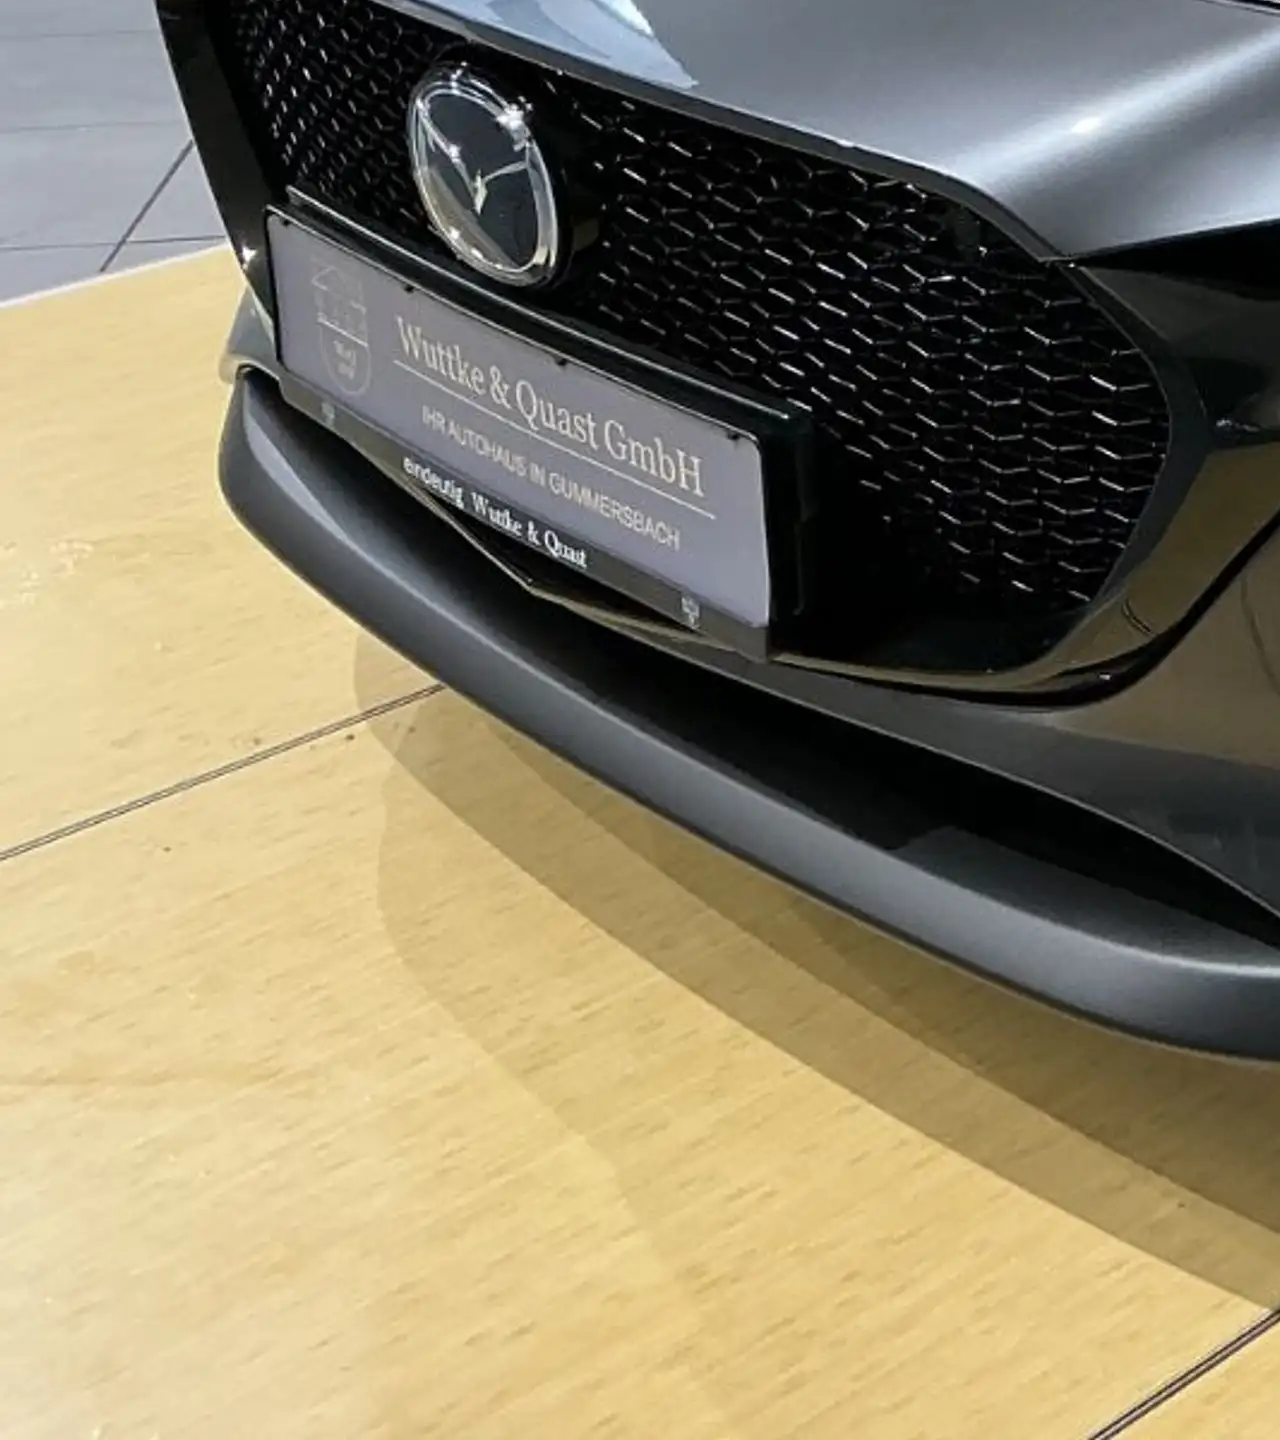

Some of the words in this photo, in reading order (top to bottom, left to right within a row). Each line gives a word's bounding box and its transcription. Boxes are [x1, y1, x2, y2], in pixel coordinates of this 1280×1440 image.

[395, 314, 486, 396] Wuttke
[489, 364, 512, 410] &
[515, 379, 600, 451] Quast
[604, 419, 705, 498] GmbH
[421, 404, 446, 434] IHR
[448, 419, 527, 476] AUTOHAUS
[530, 462, 547, 487] IN
[549, 471, 681, 552] GUMMERSBACH
[471, 491, 523, 538] Wuttke
[544, 529, 588, 569] Quast
